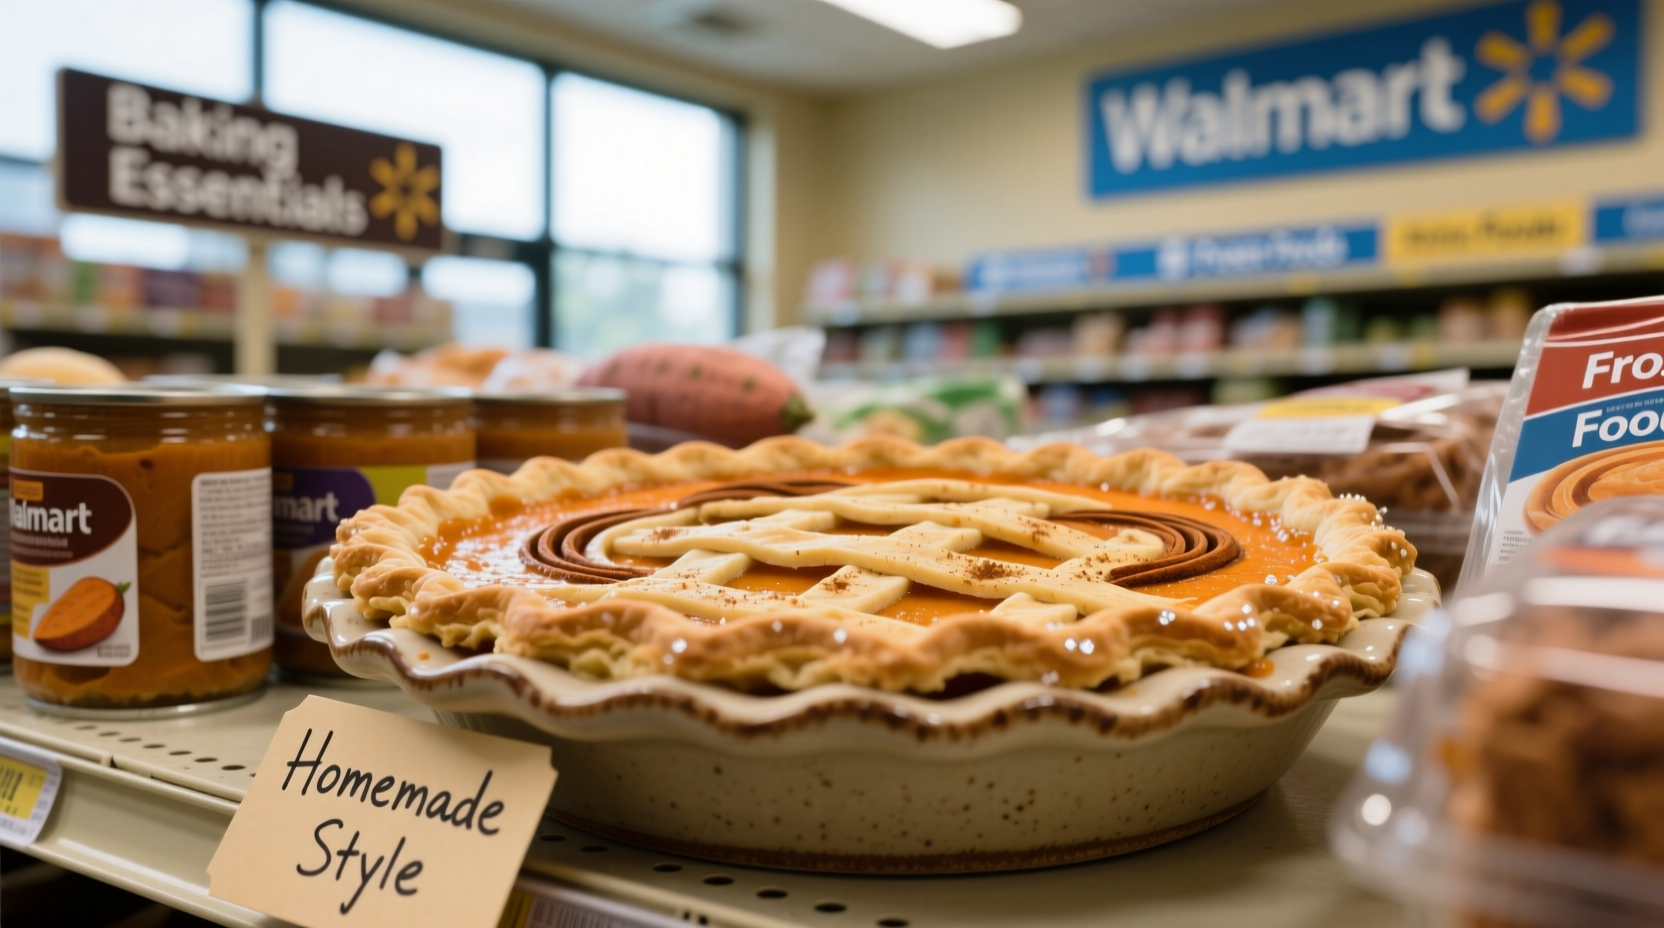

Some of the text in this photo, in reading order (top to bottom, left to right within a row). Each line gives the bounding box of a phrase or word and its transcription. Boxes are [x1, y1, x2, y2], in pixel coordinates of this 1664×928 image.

[106, 82, 299, 177] Baking
[1102, 36, 1467, 174] Walmart
[108, 146, 369, 236] Essentials
[1582, 351, 1664, 389] Fro
[281, 728, 504, 836] Homemade
[296, 818, 423, 915] Style
